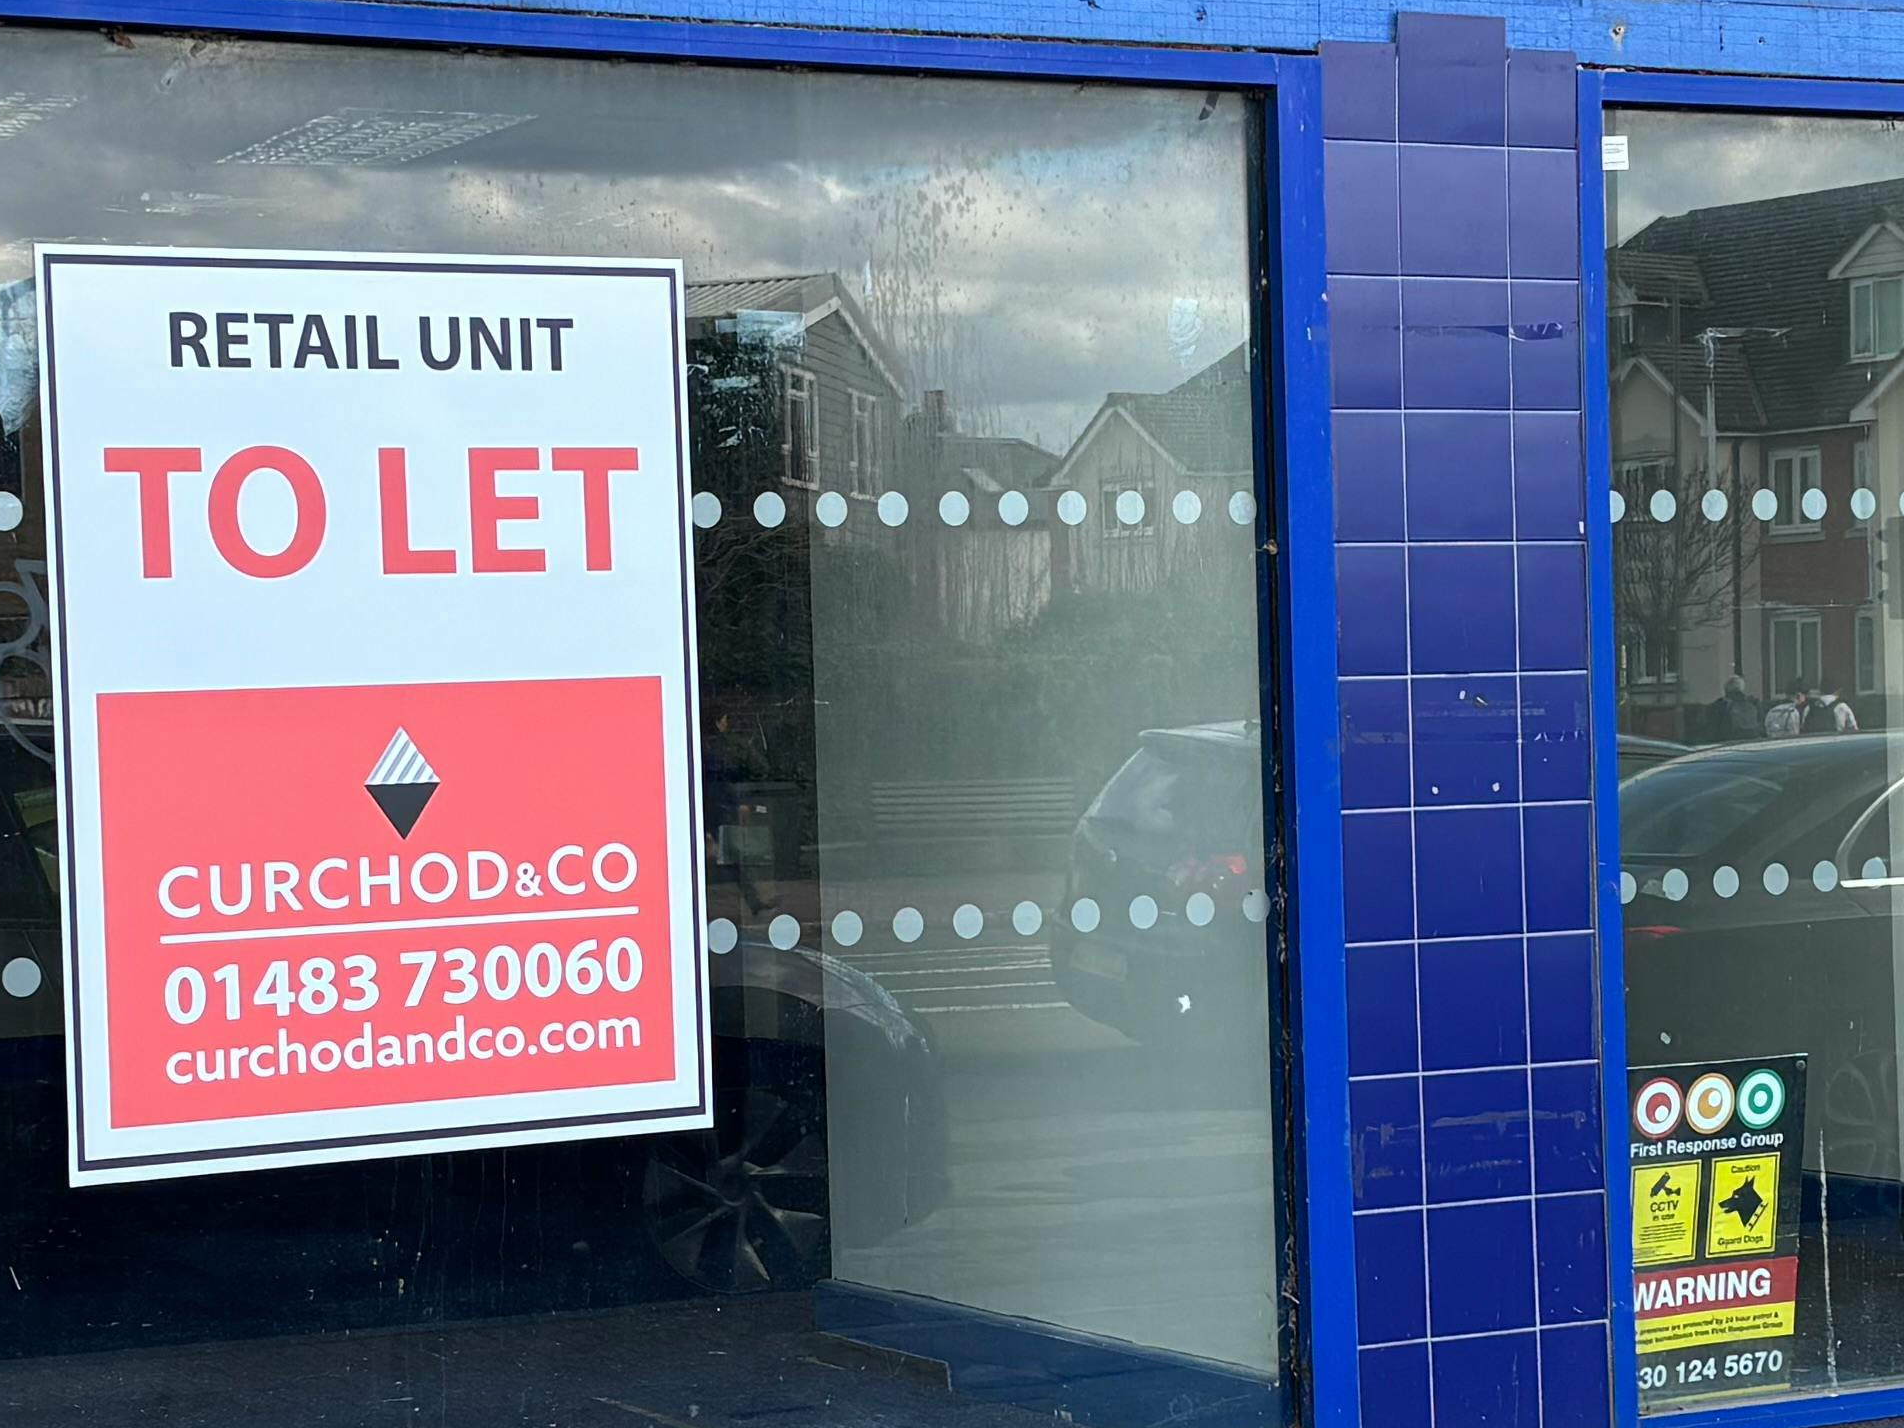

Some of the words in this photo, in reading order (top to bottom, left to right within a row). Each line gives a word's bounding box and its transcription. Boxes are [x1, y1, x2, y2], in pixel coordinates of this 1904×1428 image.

[167, 311, 400, 371] RETAIL
[418, 316, 574, 372] UNIT
[103, 444, 328, 579] TO
[377, 446, 639, 576] LET
[157, 842, 639, 919] CURCHOD&CO
[164, 953, 381, 1025] 01483
[399, 936, 643, 1008] 730060
[165, 1015, 641, 1085] curchodandco.com
[1630, 1142, 1662, 1159] First
[1666, 1137, 1737, 1155] Response
[1740, 1132, 1784, 1148] Group
[1730, 1164, 1761, 1174] Caution
[1650, 1200, 1679, 1213] CCTV
[1717, 1236, 1743, 1249] Guard
[1743, 1234, 1764, 1245] Dogs
[1633, 1267, 1771, 1313] WARNING
[1675, 1357, 1717, 1384] 124
[1724, 1349, 1783, 1378] 5670
